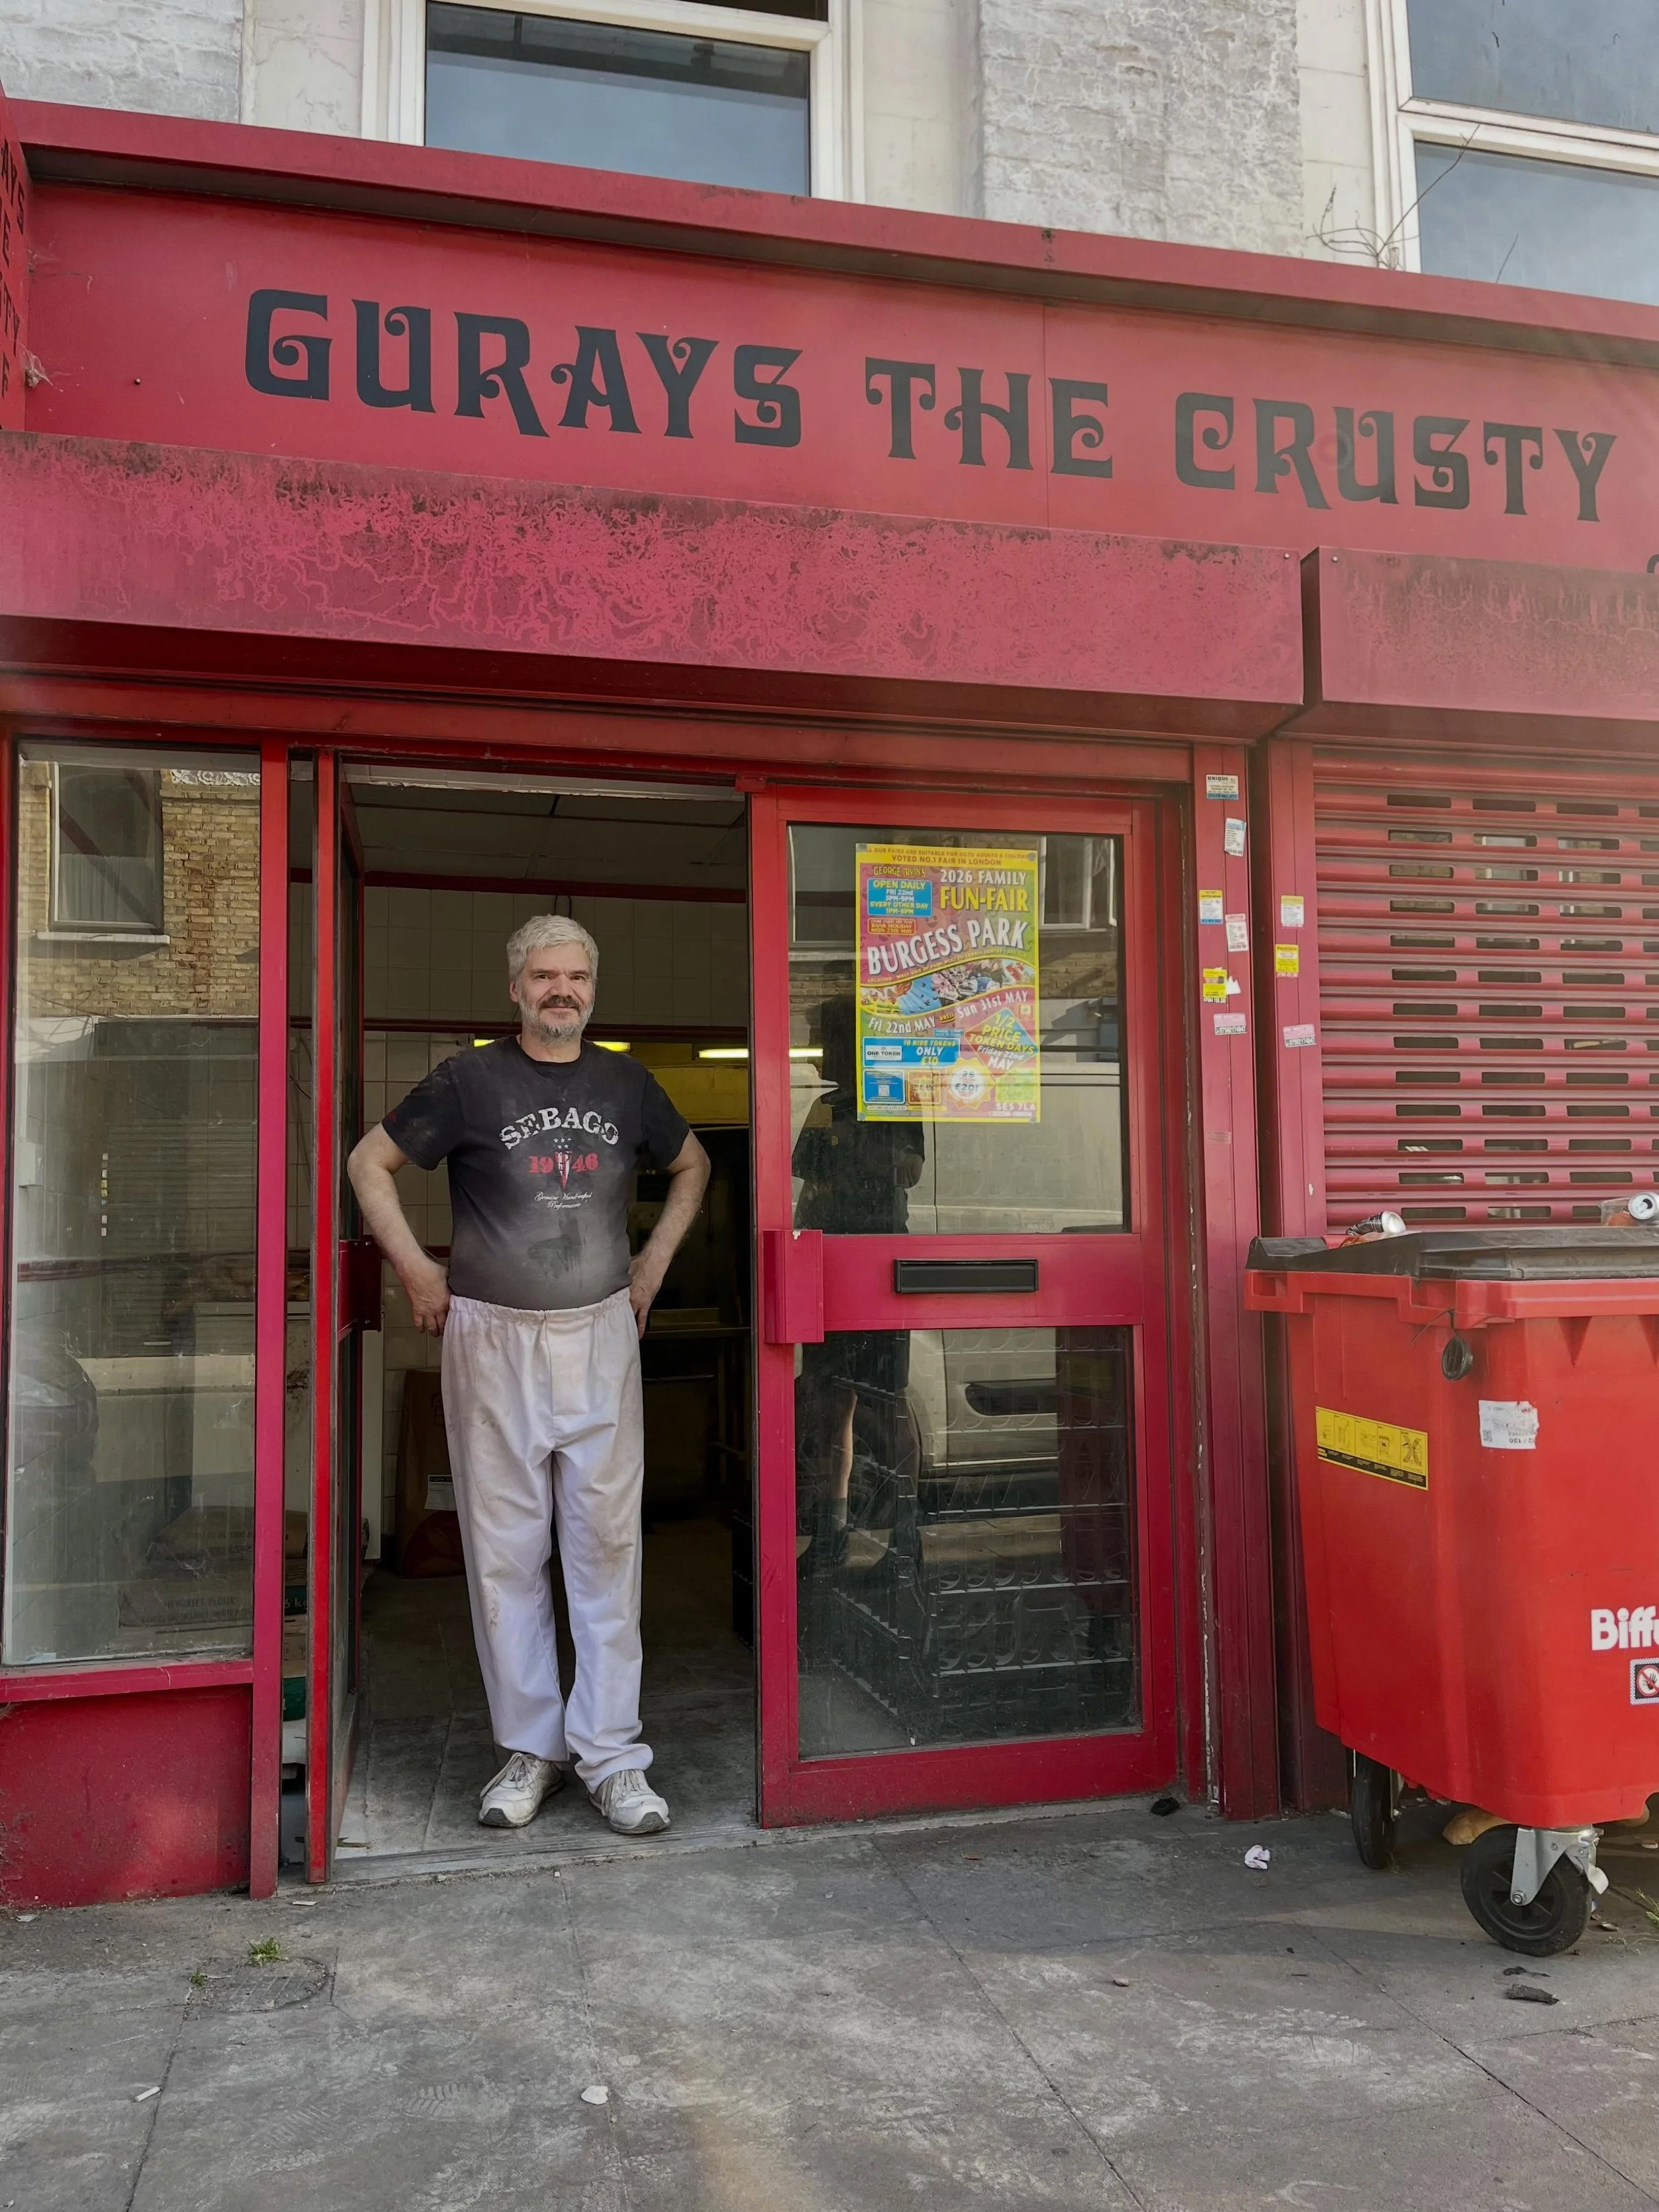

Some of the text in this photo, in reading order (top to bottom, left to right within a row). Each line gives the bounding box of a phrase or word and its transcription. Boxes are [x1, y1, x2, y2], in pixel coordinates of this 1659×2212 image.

[245, 289, 1617, 522] GURAYS THE CRUSTY
[873, 865, 901, 877] GEORGE
[940, 869, 1027, 885] 2026 FAMILY
[901, 881, 926, 889] DAILY
[940, 886, 1029, 912] FUN-FAIR
[867, 917, 1028, 975] BURGESS PARK
[939, 990, 1028, 1021] UNTIL Sun 31st MAY
[868, 1015, 936, 1033] Fri 22nd MAY
[995, 1013, 1016, 1028] 1/2
[982, 1024, 1021, 1043] PRICE
[916, 1047, 944, 1056] ONLY
[969, 1033, 1035, 1055] TOKEN DAYS
[977, 1045, 1024, 1061] Friday 22nd
[987, 1055, 1015, 1070] MAY
[499, 1107, 620, 1149] SEBAGO
[528, 1152, 600, 1174] 19 46
[208, 1596, 237, 1607] FLOUR
